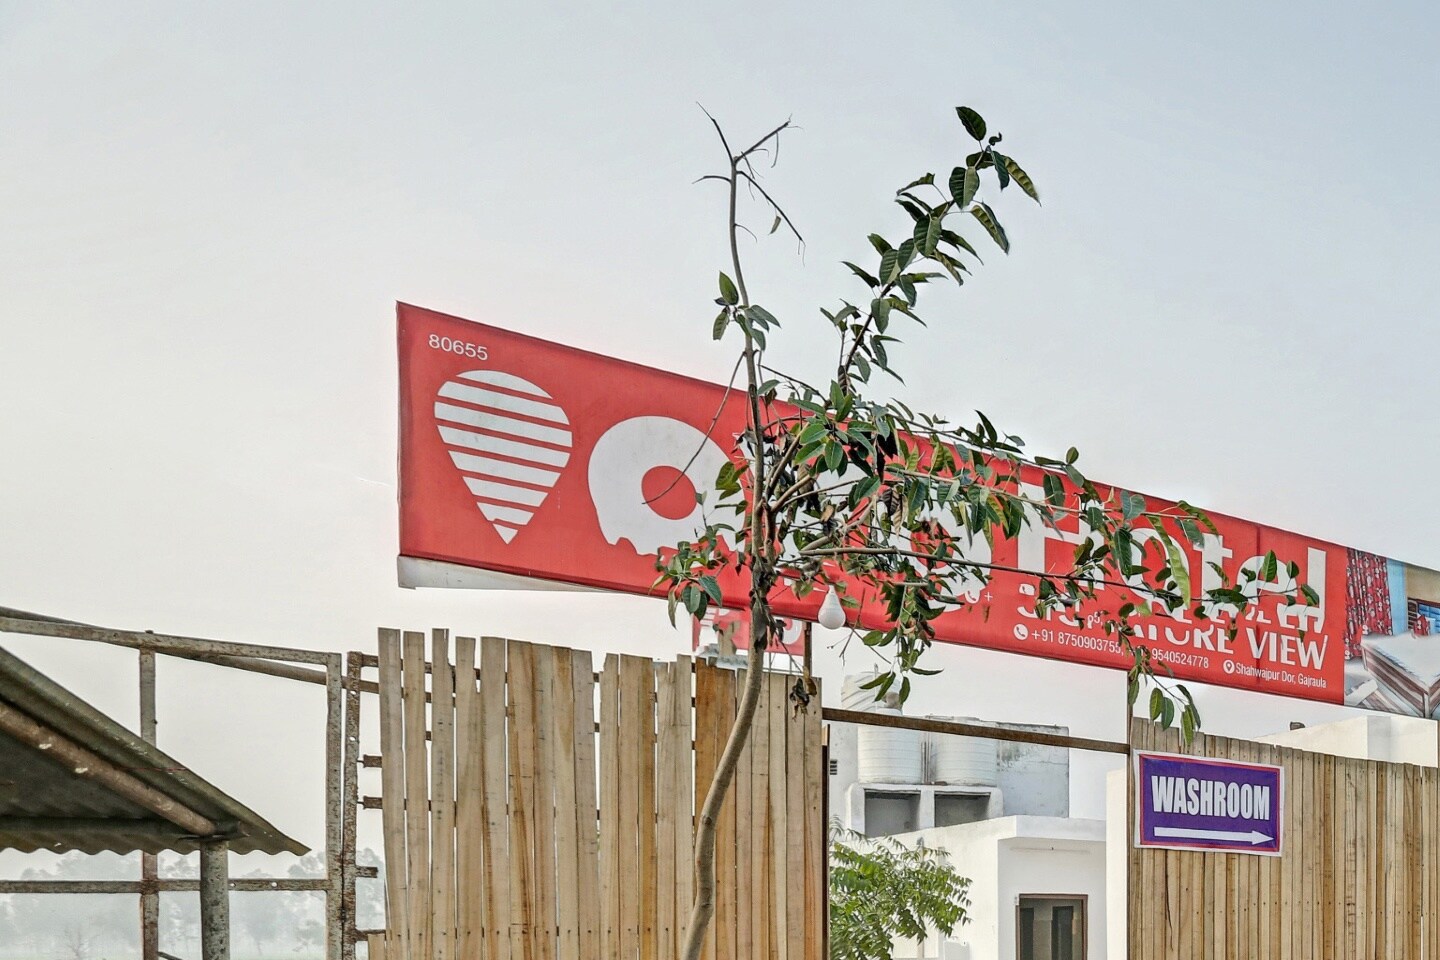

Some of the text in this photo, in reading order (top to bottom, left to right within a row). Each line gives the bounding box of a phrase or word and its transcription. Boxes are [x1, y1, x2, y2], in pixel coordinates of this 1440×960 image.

[428, 333, 489, 361] 80655
[1031, 629, 1054, 643] +91
[1151, 649, 1210, 669] 9540524778
[1246, 627, 1329, 671] VIEW
[1297, 673, 1327, 689] Gajraula
[1150, 775, 1270, 821] WASHROOM
